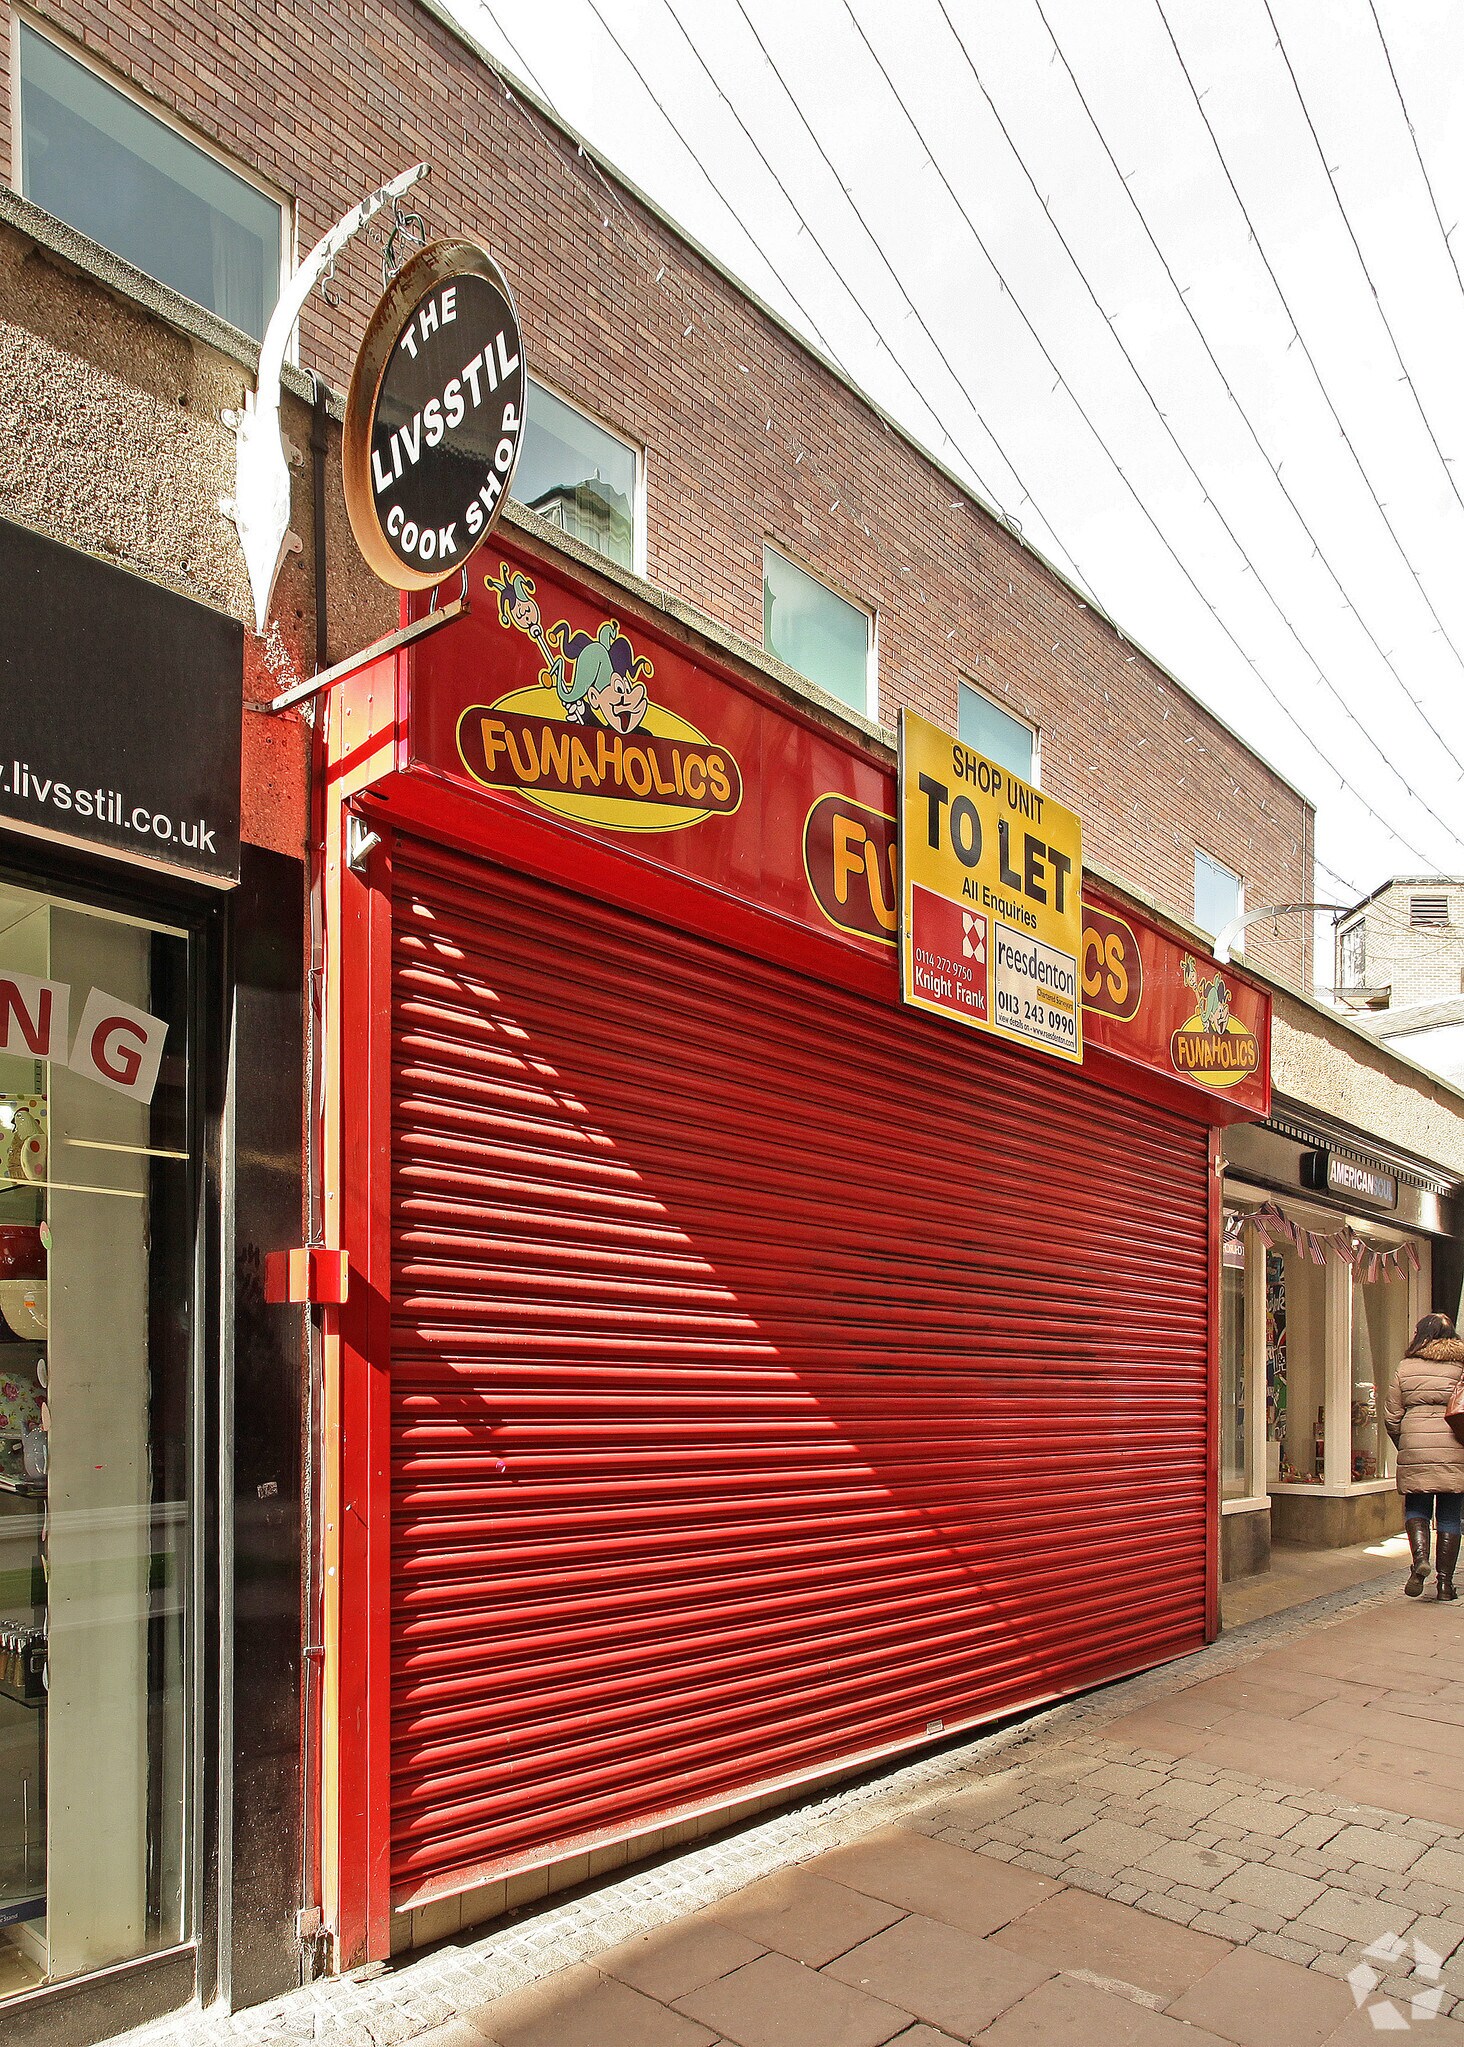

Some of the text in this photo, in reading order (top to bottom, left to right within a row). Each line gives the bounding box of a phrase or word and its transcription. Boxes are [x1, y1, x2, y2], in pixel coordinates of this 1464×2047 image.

[400, 286, 458, 359] THE
[371, 330, 520, 495] LIVSSTIL
[387, 402, 521, 561] COOK SHOP
[480, 717, 731, 802] FUNAHOLICS
[952, 744, 1044, 825] SHOP UNIT
[0, 760, 217, 855] .livsstil.co.uk
[919, 771, 1072, 915] TO LET
[961, 876, 1038, 930] All Enquiries
[915, 947, 973, 982] 0114 272 9750
[915, 965, 986, 1011] Knight Frank
[998, 941, 1074, 996] reesdenton
[998, 990, 1074, 1036] 0113 243 0990
[1009, 1016, 1024, 1030] details
[1177, 1034, 1256, 1069] FUNAHOLICS
